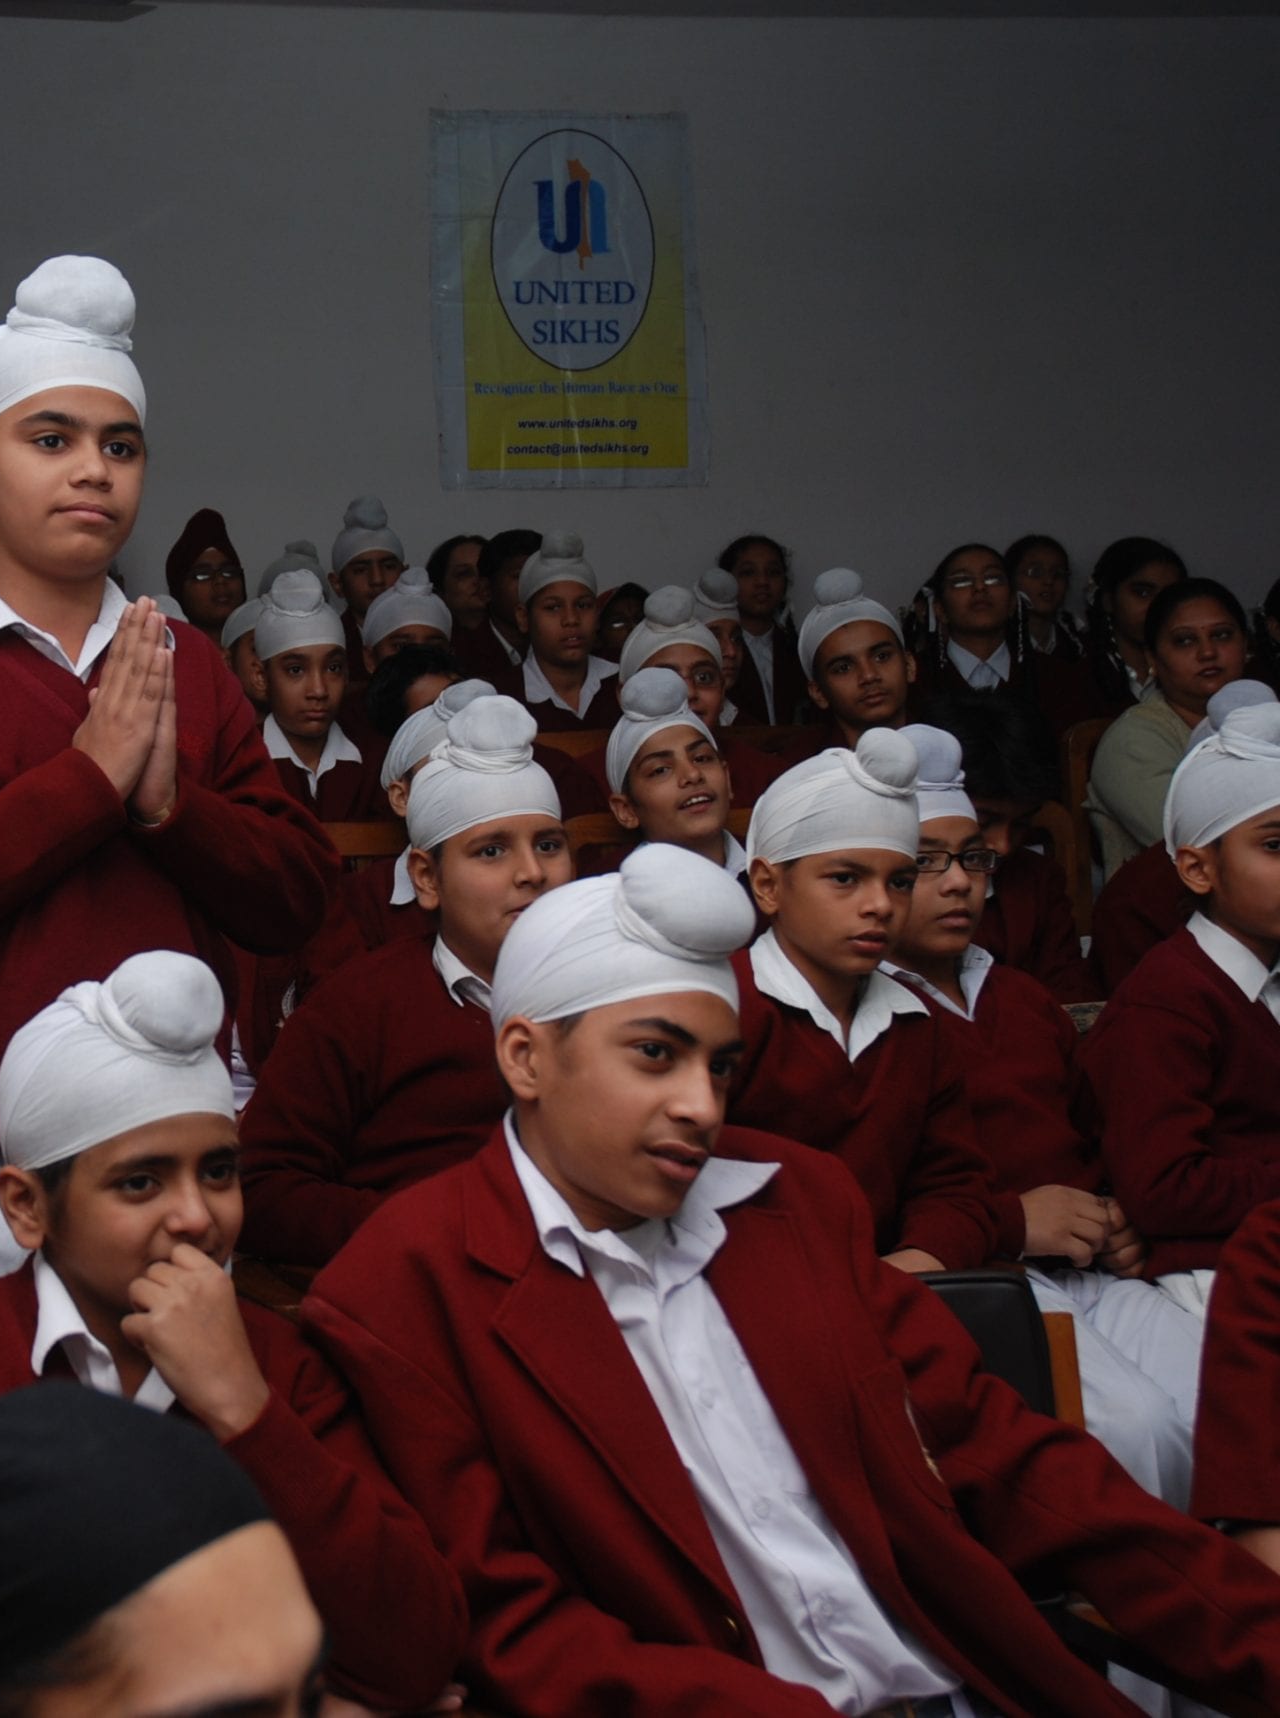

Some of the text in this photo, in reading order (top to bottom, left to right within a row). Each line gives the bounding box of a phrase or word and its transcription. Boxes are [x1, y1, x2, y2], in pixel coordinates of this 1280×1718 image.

[513, 280, 636, 305] UNITED
[532, 320, 620, 345] SIKHS
[474, 382, 679, 397] Recognize the Human Race as One
[517, 417, 638, 431] www.unitedsikhs.org
[506, 442, 650, 457] contact@unitedsikhs.org
